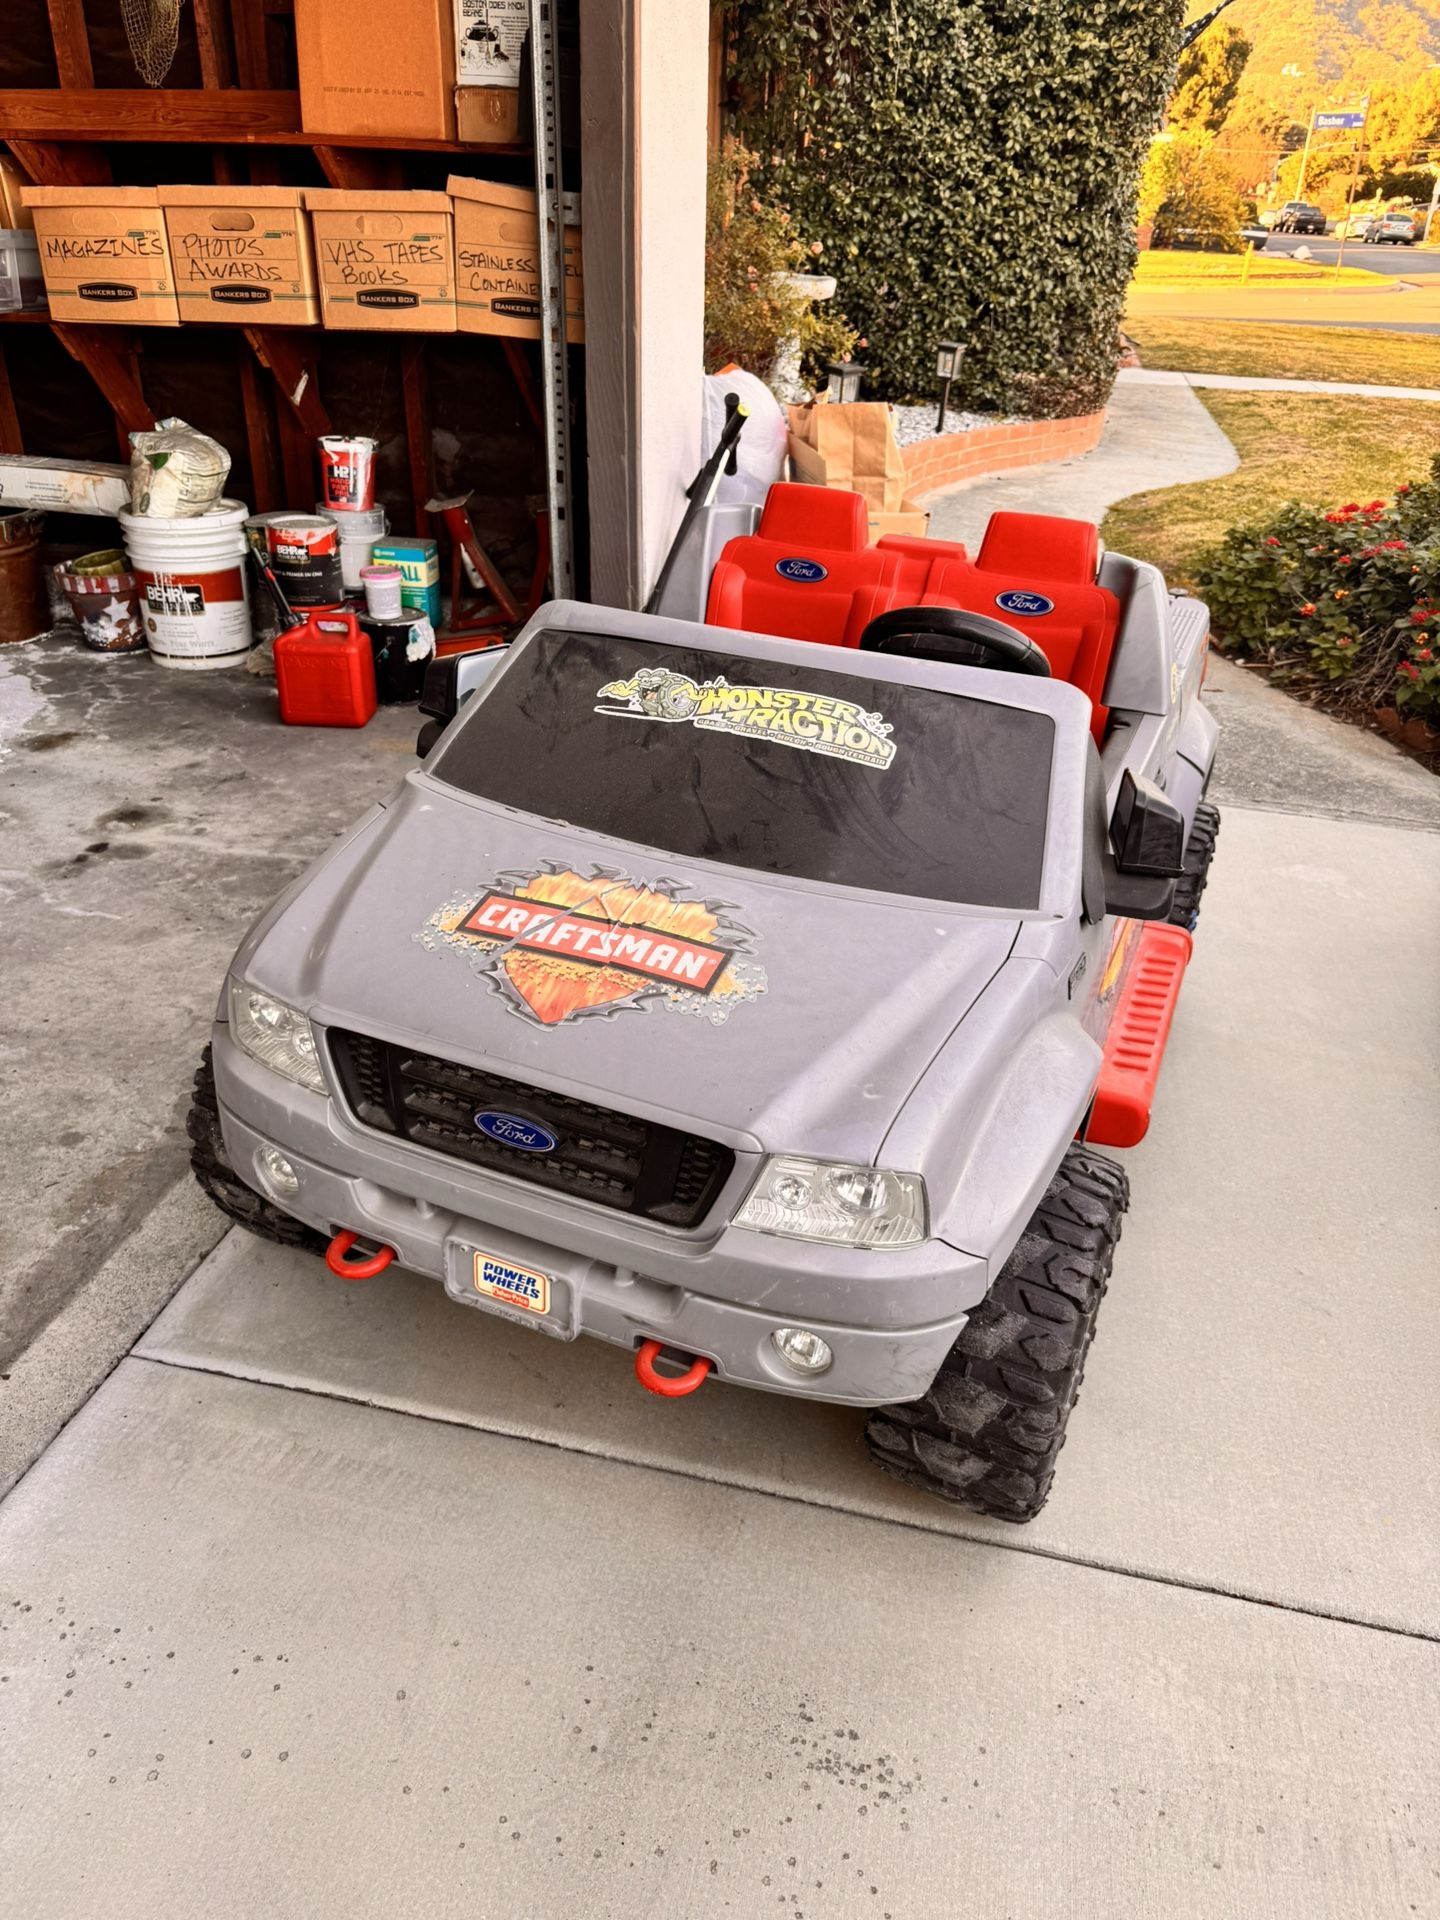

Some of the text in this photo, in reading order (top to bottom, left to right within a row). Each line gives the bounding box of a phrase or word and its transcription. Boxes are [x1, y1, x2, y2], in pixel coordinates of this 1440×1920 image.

[46, 236, 165, 262] MAGAZINES
[182, 233, 264, 261] PHOTOS
[326, 240, 443, 266] VHS TAPES
[189, 258, 282, 281] AWARDS
[458, 250, 536, 274] STAINLESS
[82, 288, 133, 297] BANKERS BOX
[214, 290, 267, 299] BANKERS BOX
[469, 271, 538, 297] CONTAINE
[360, 295, 415, 304] BANKERS BOX
[787, 561, 816, 577] Ford
[146, 585, 182, 602] BEHR
[1008, 594, 1041, 610] Ford
[693, 686, 859, 723] MONSTER
[724, 707, 893, 758] TRACTION
[734, 725, 769, 738] GRAVEL
[775, 733, 807, 747] MULCH
[814, 742, 846, 755] ROUGH
[846, 750, 888, 766] TERRAIN
[478, 903, 706, 979] CRAFTSMAN
[491, 1118, 535, 1145] Ford
[483, 1272, 540, 1299] WHEELS
[484, 1262, 536, 1287] POWER
